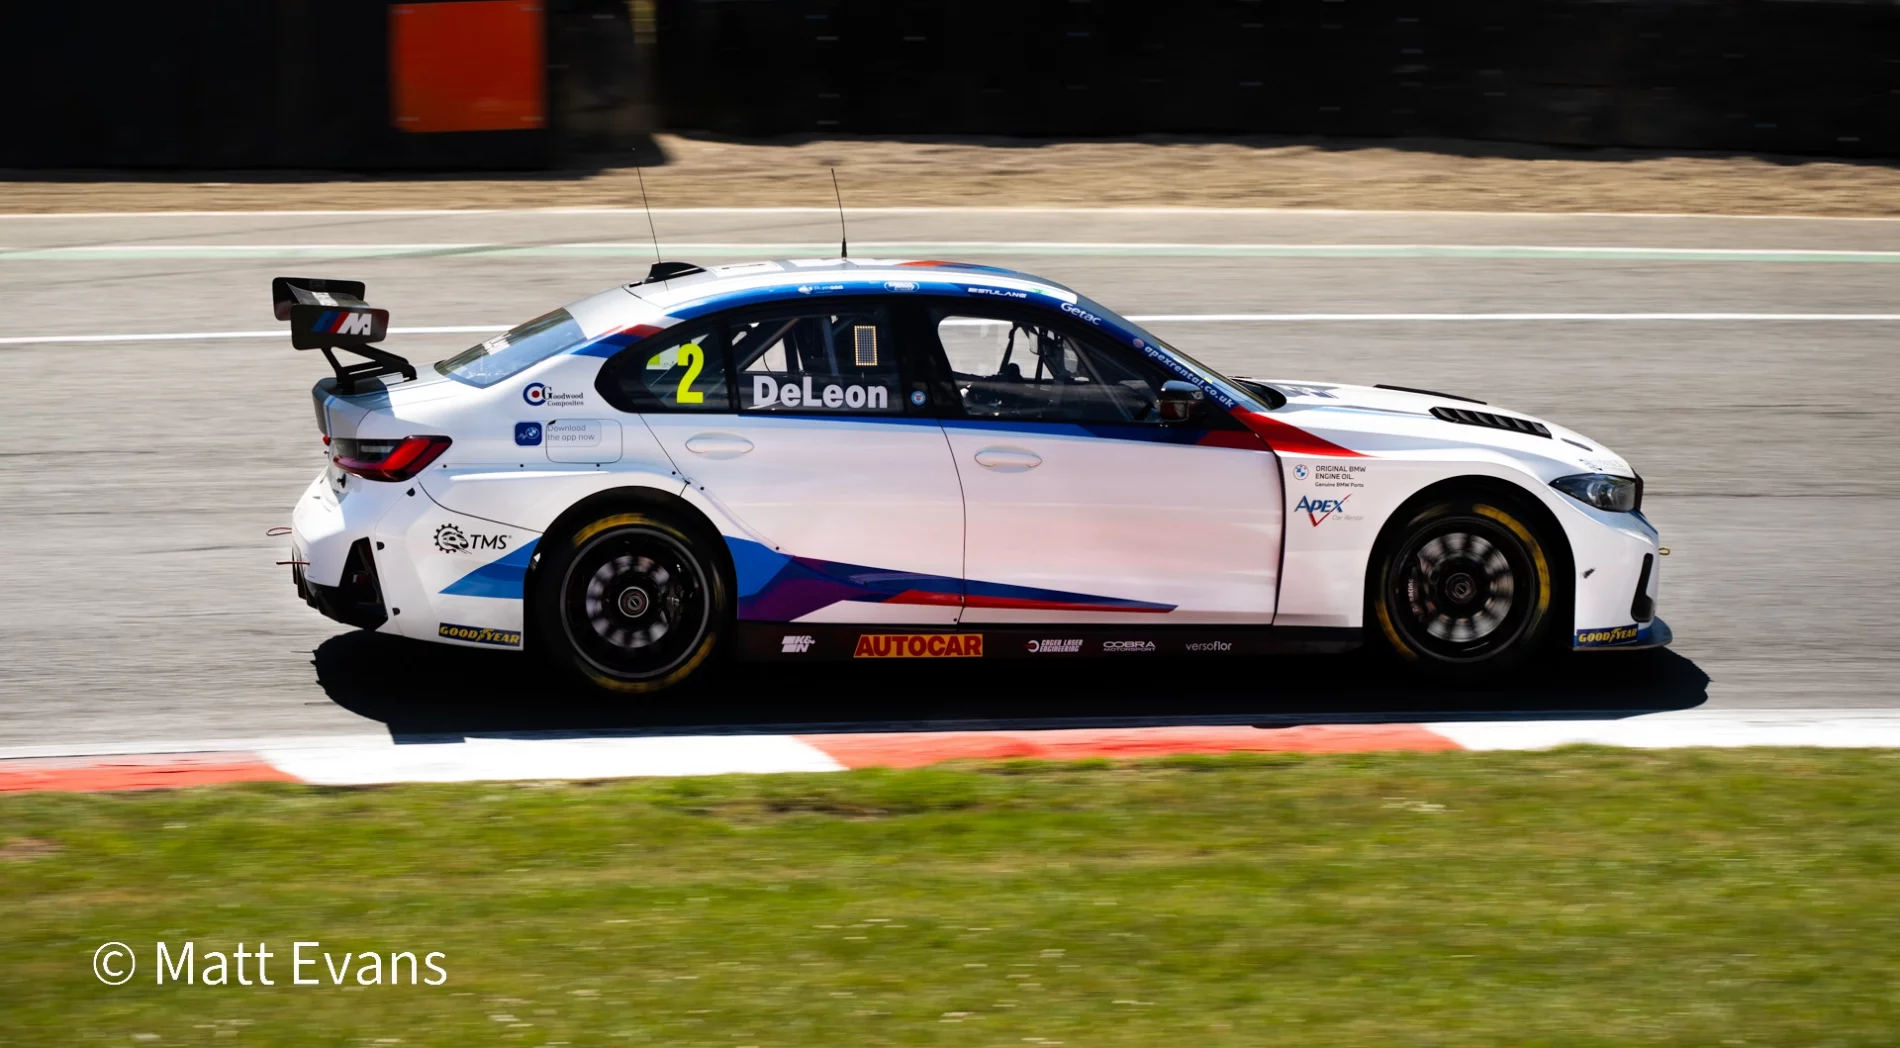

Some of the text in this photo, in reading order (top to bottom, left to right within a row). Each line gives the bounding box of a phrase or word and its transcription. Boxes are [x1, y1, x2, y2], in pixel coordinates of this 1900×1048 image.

[1061, 302, 1101, 325] Getac
[676, 343, 704, 404] 2
[1145, 346, 1234, 408] apexrental.co.uk
[541, 386, 584, 400] Goodwood
[753, 375, 888, 408] DeLeon
[439, 626, 520, 644] GOODYEAR
[1103, 640, 1156, 648] COBRA
[1578, 628, 1637, 643] GOODYEAR
[856, 635, 982, 657] AUTOCAR
[1185, 641, 1232, 651] versoflor
